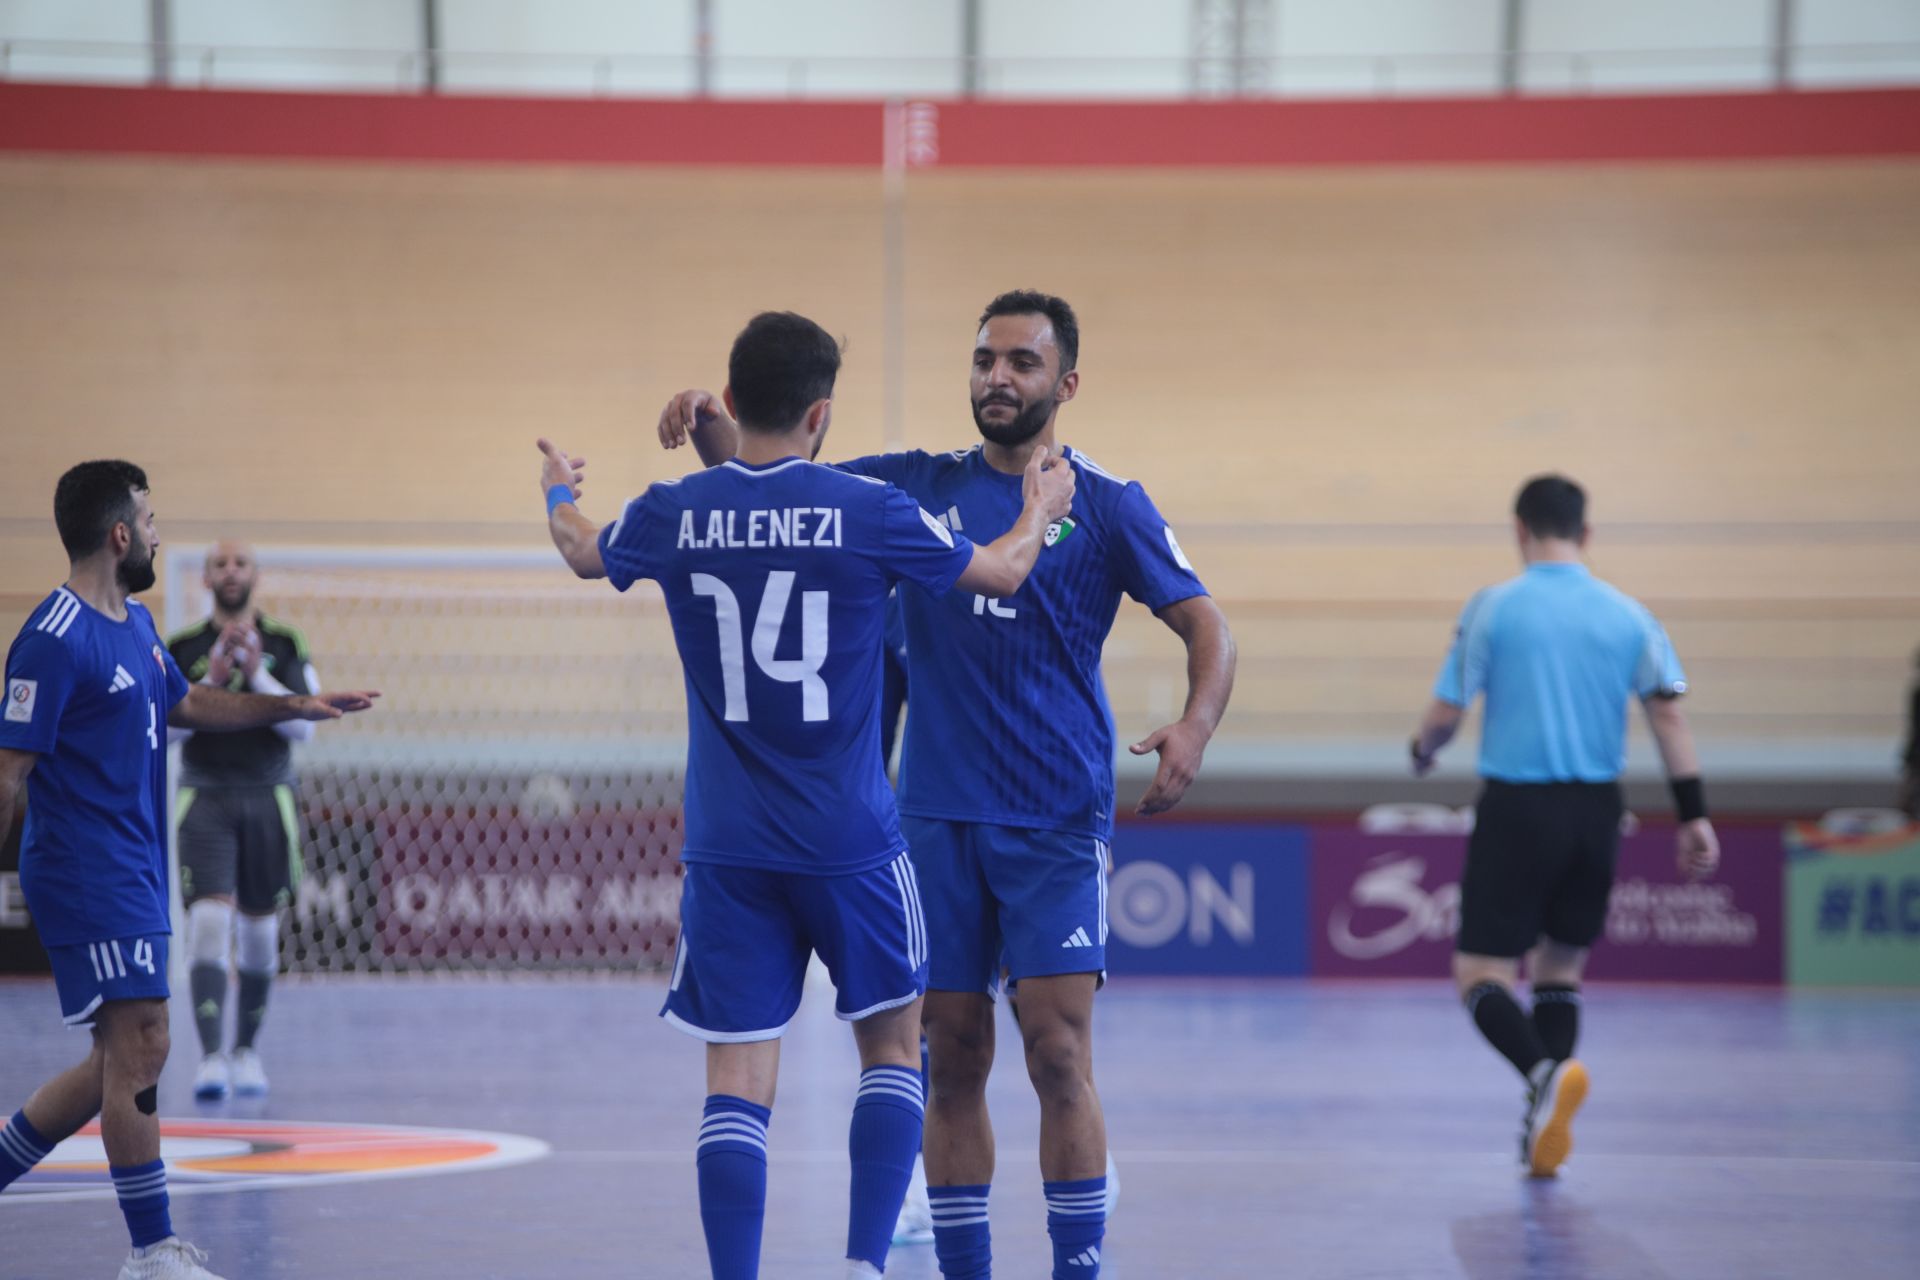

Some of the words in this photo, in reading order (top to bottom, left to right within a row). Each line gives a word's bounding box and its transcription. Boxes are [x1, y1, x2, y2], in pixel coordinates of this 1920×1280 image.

[677, 507, 842, 549] A.ALENEZI
[690, 570, 829, 722] 14
[134, 938, 155, 975] 4
